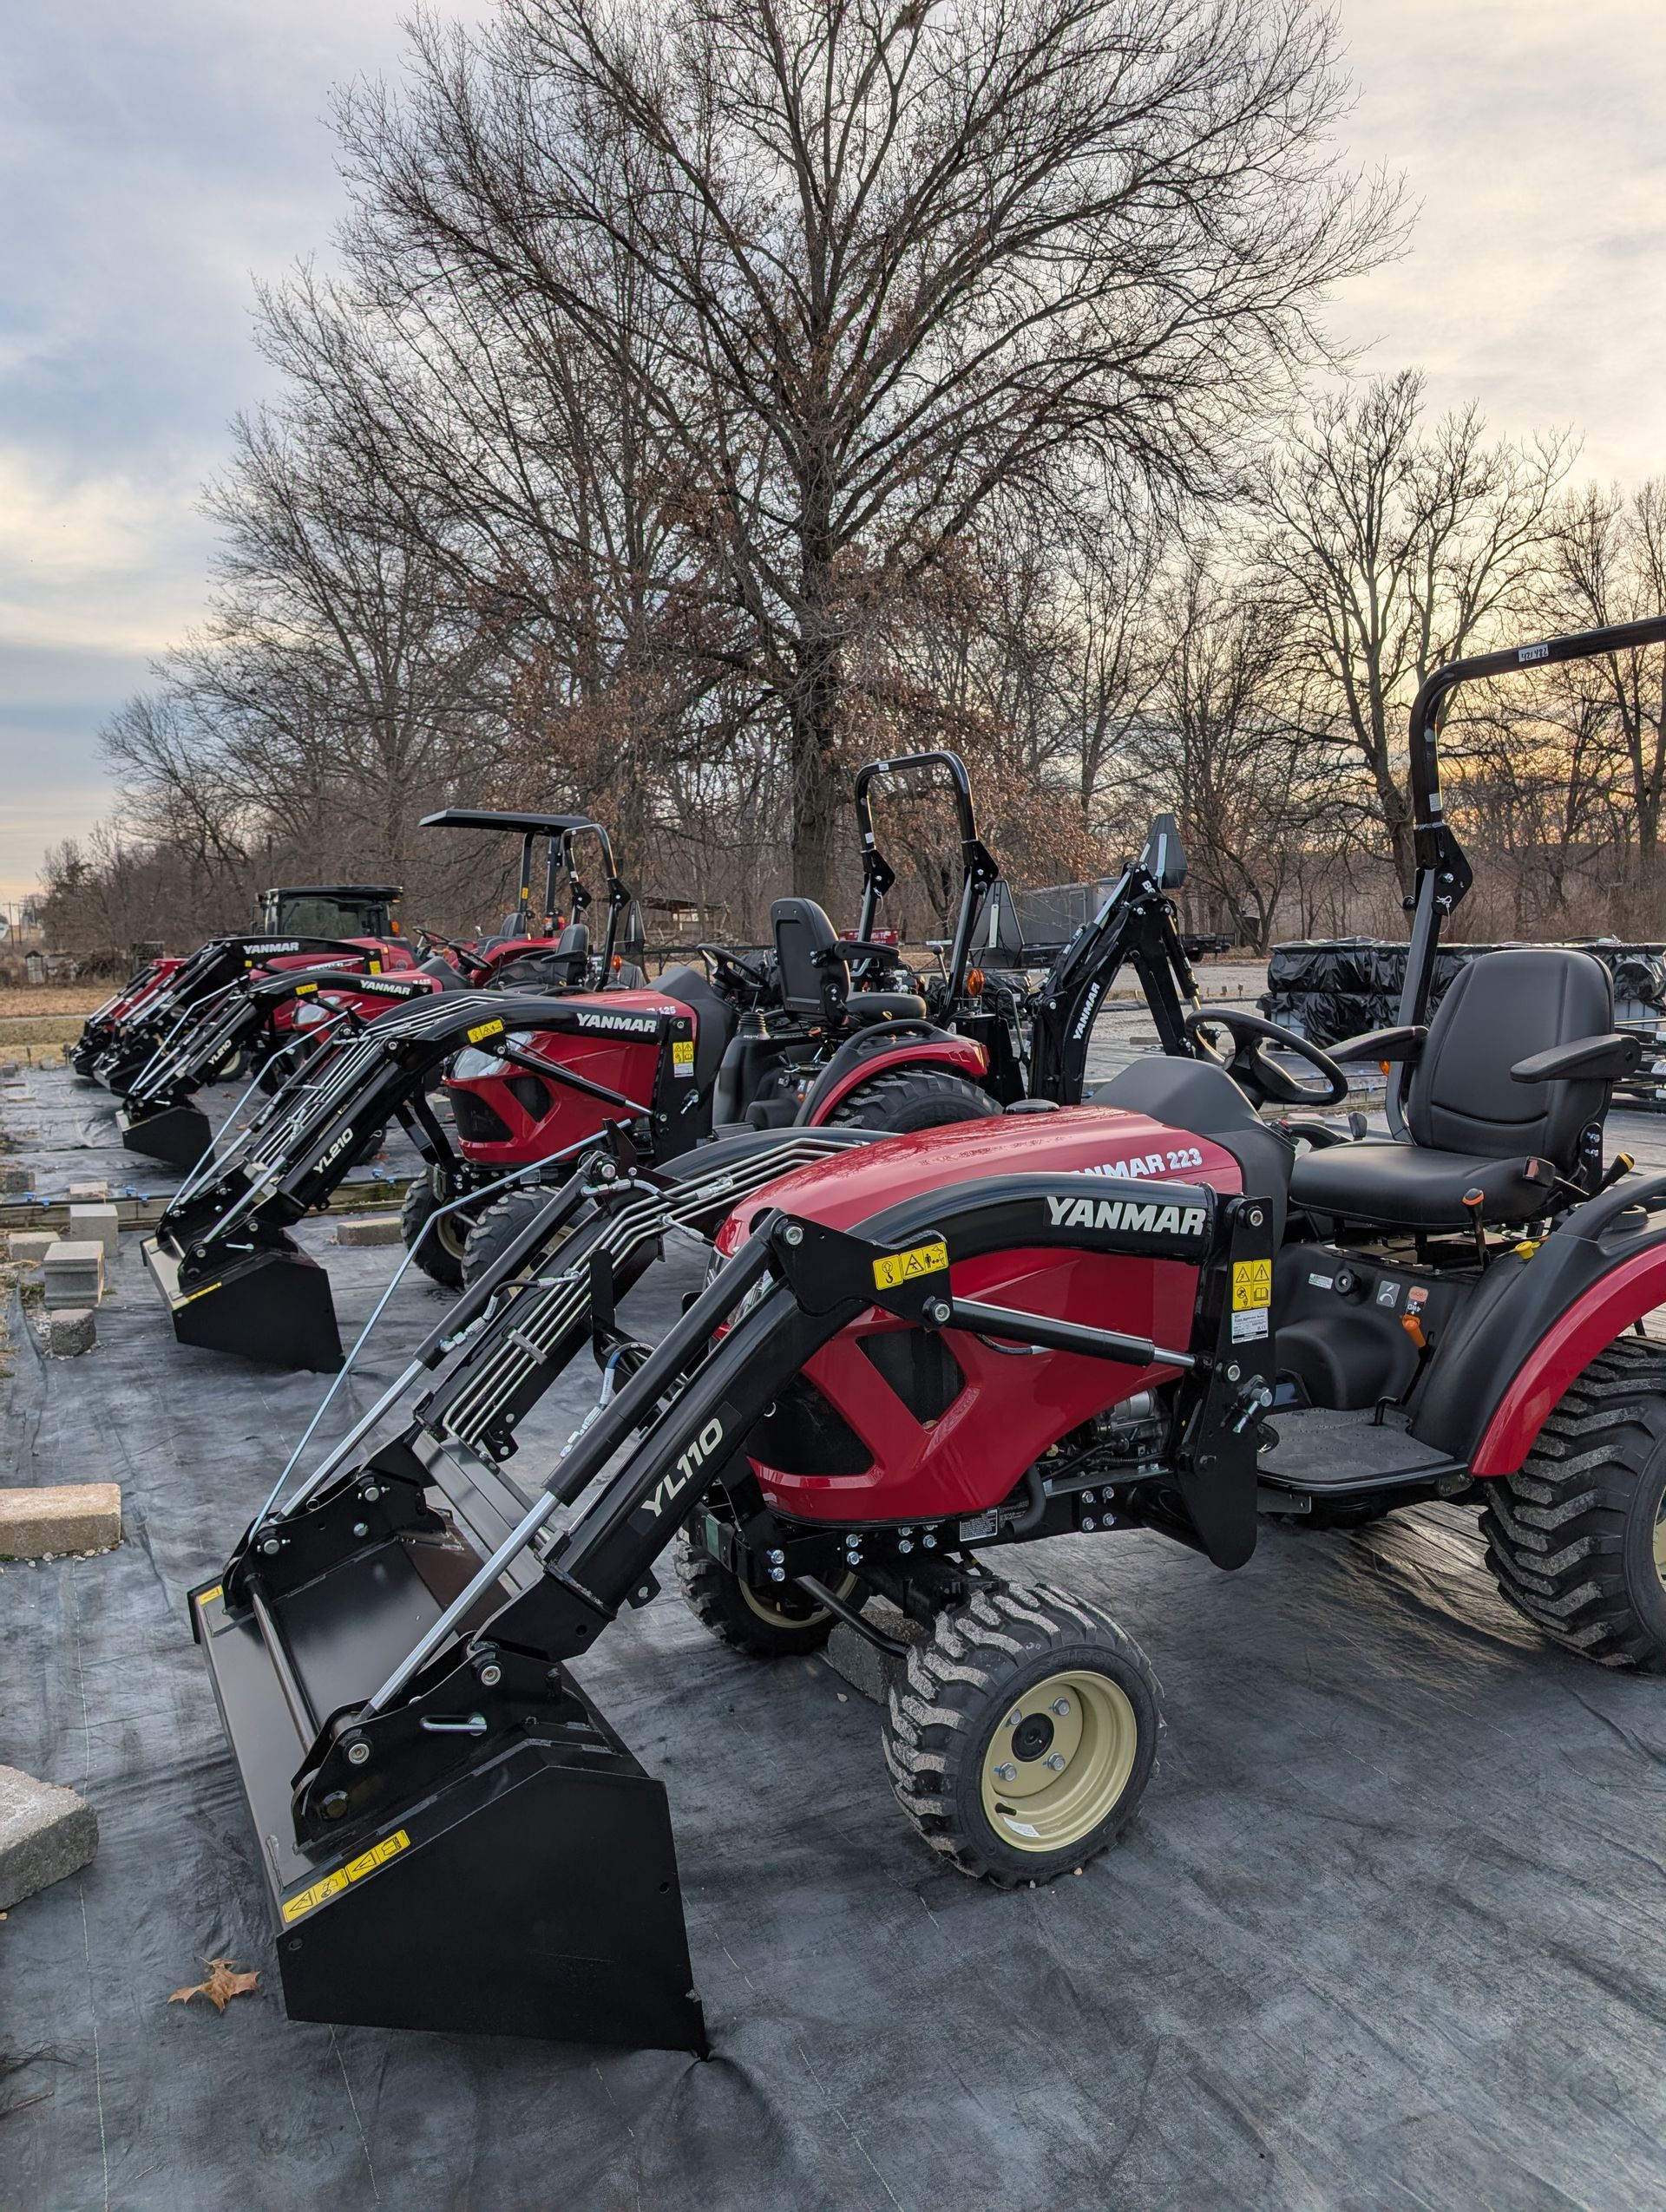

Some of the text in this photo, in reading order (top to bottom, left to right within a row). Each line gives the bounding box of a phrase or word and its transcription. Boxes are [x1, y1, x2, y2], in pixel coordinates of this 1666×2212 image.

[243, 942, 299, 954] YANMAR
[360, 979, 410, 995] YANMAR
[576, 1013, 657, 1032] YANMAR
[1072, 982, 1100, 1039] YANMAR
[208, 1039, 232, 1065] YL210
[313, 1128, 353, 1173] YL210
[1071, 1148, 1203, 1178] NMAR 223
[1046, 1196, 1206, 1235] YANMAR
[640, 1417, 723, 1516] YL110
